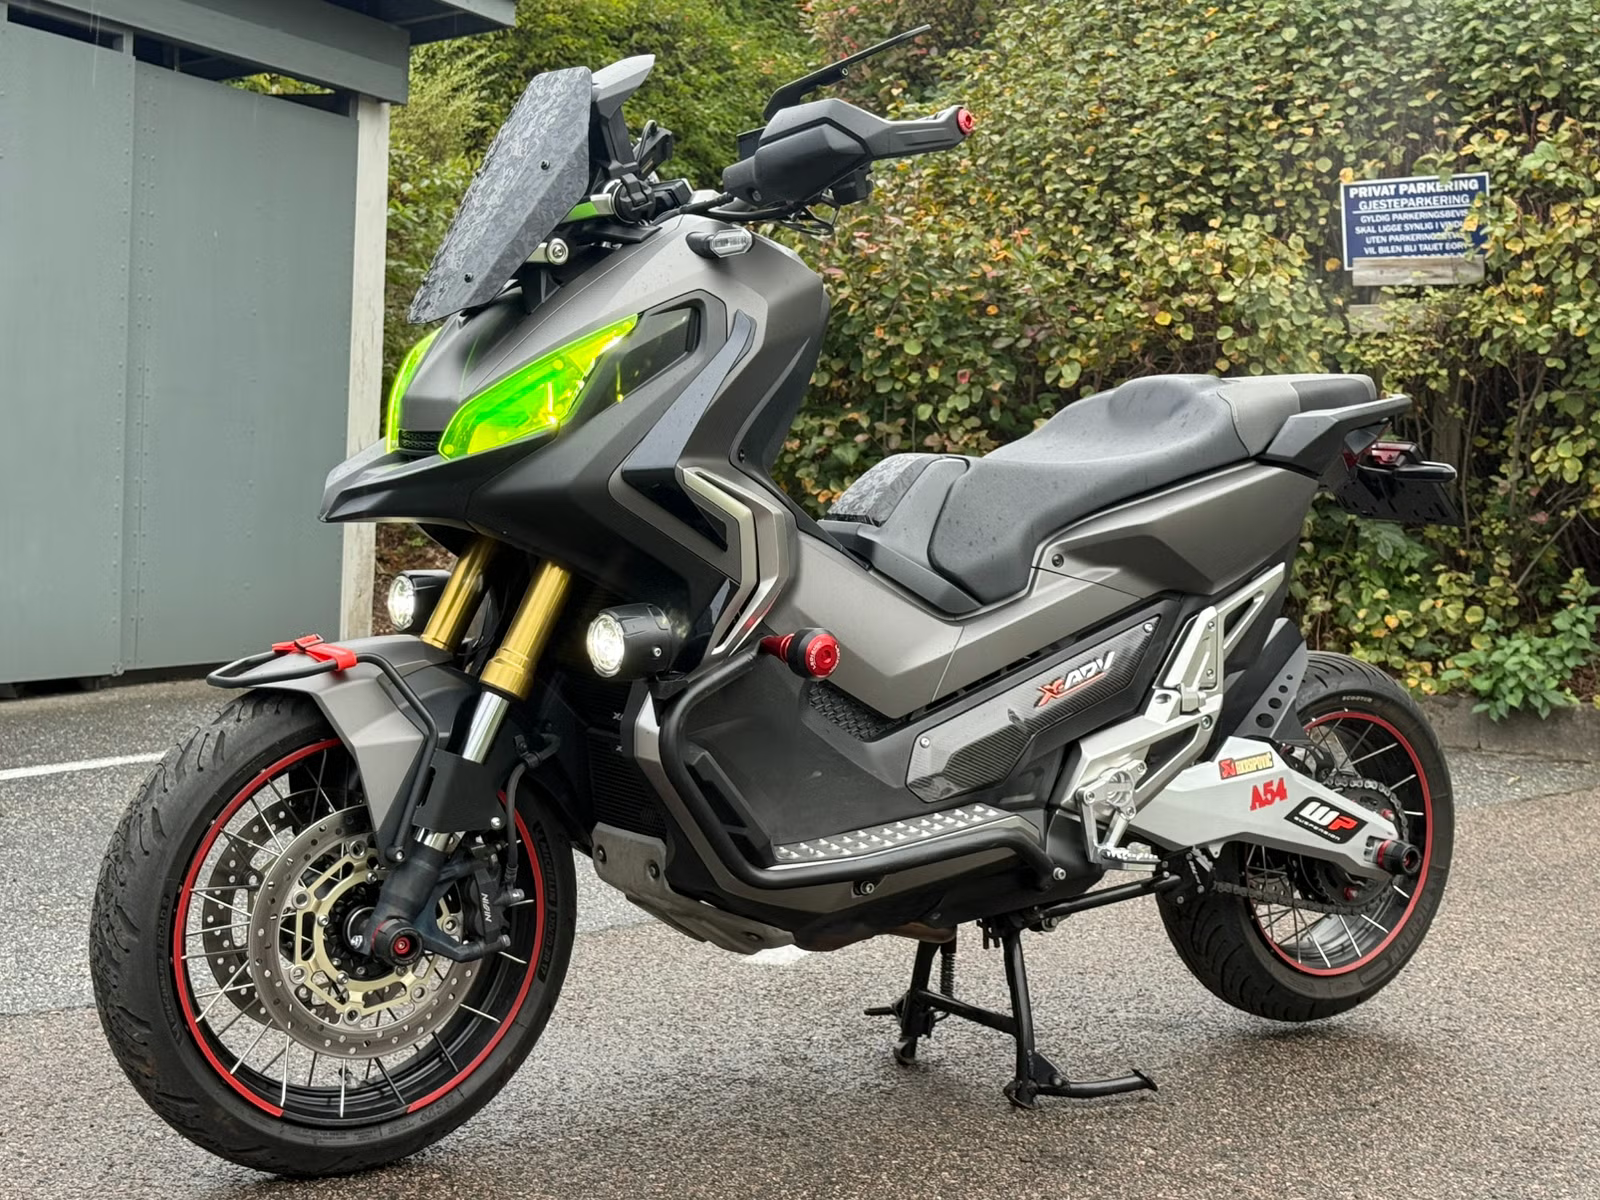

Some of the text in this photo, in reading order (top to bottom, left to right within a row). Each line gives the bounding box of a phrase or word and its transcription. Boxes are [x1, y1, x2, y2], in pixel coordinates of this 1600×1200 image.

[1349, 179, 1479, 199] PRIVAT PARKERING
[1359, 194, 1470, 210] GJESTEPARKERING
[1360, 213, 1391, 223] GYLDIG
[1354, 225, 1377, 235] SKAL
[1378, 223, 1402, 233] LIGGE
[1403, 221, 1434, 231] SYNLIG
[1366, 235, 1388, 244] UTEN
[1363, 246, 1377, 255] VIL
[1378, 244, 1403, 254] BILEN
[1404, 243, 1417, 253] BLI
[1250, 777, 1288, 811] A54
[1298, 801, 1359, 831] WP
